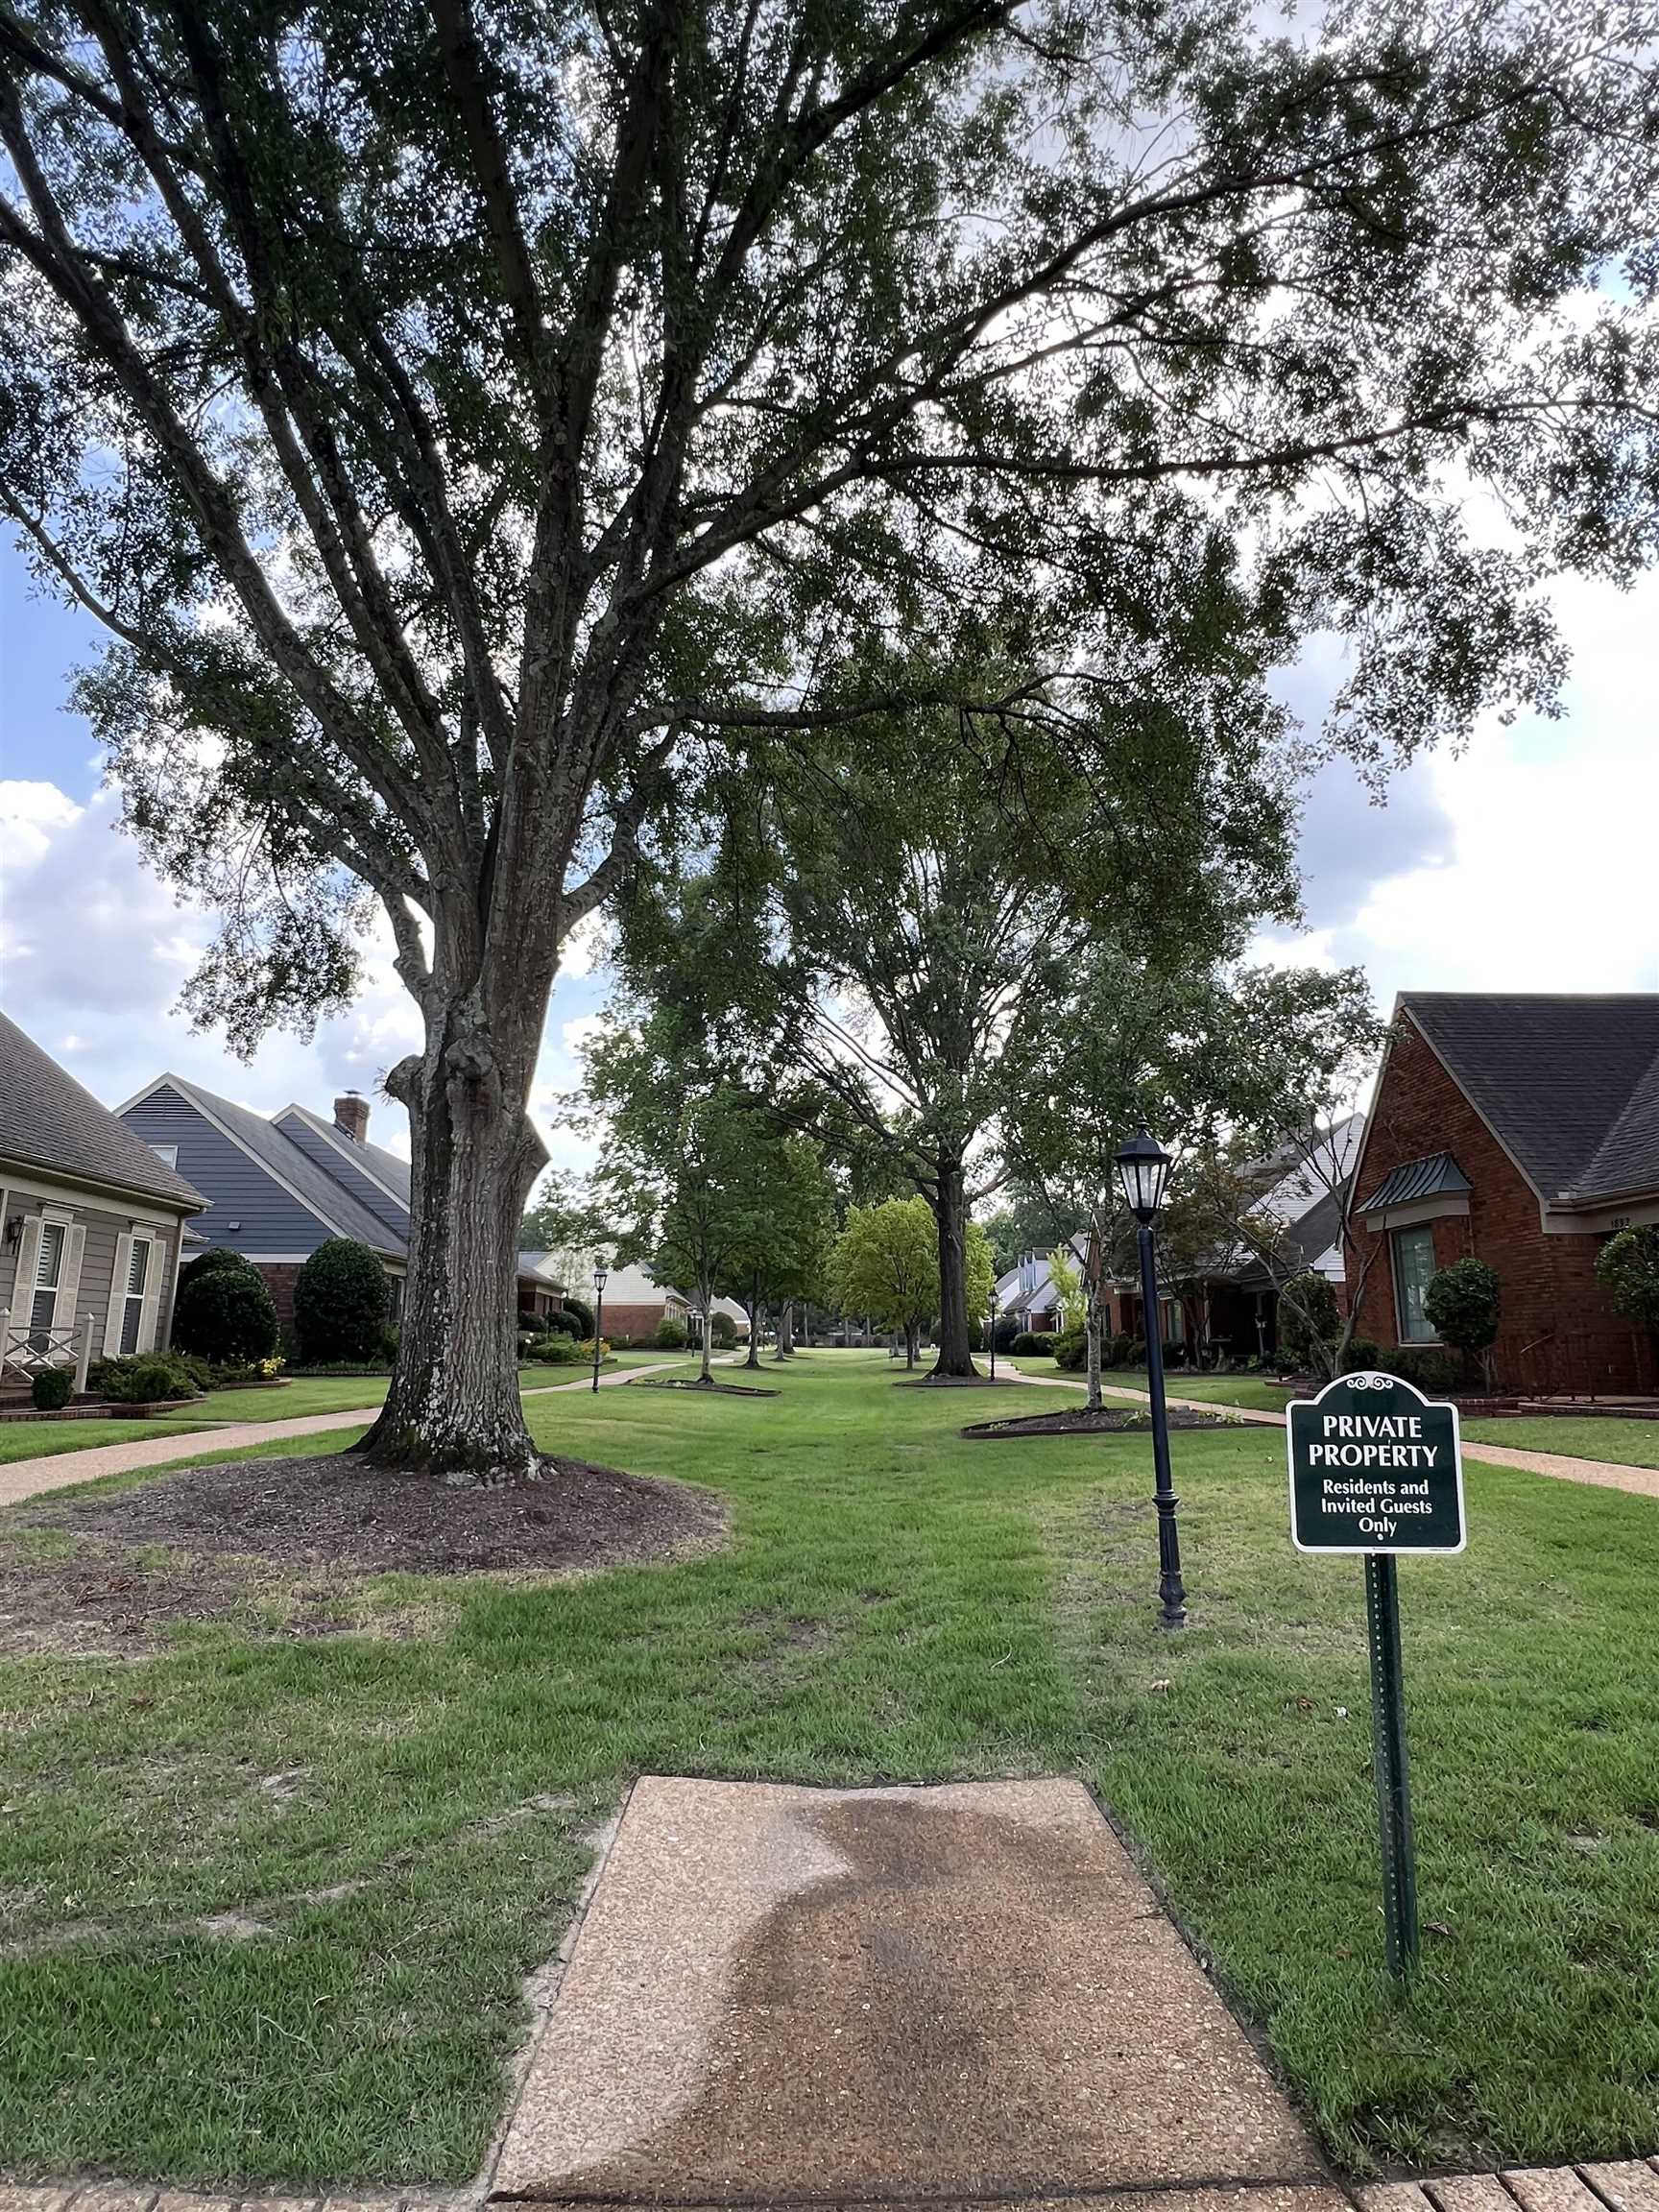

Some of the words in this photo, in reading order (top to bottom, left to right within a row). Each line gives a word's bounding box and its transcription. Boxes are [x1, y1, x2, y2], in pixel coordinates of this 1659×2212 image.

[1323, 1415, 1422, 1438] PRIVATE
[1309, 1444, 1438, 1467] PROPERTY
[1323, 1479, 1396, 1495] Residents
[1400, 1479, 1430, 1495] and
[1321, 1498, 1376, 1513] Invited
[1381, 1499, 1432, 1514] Guests
[1358, 1517, 1398, 1537] Only
